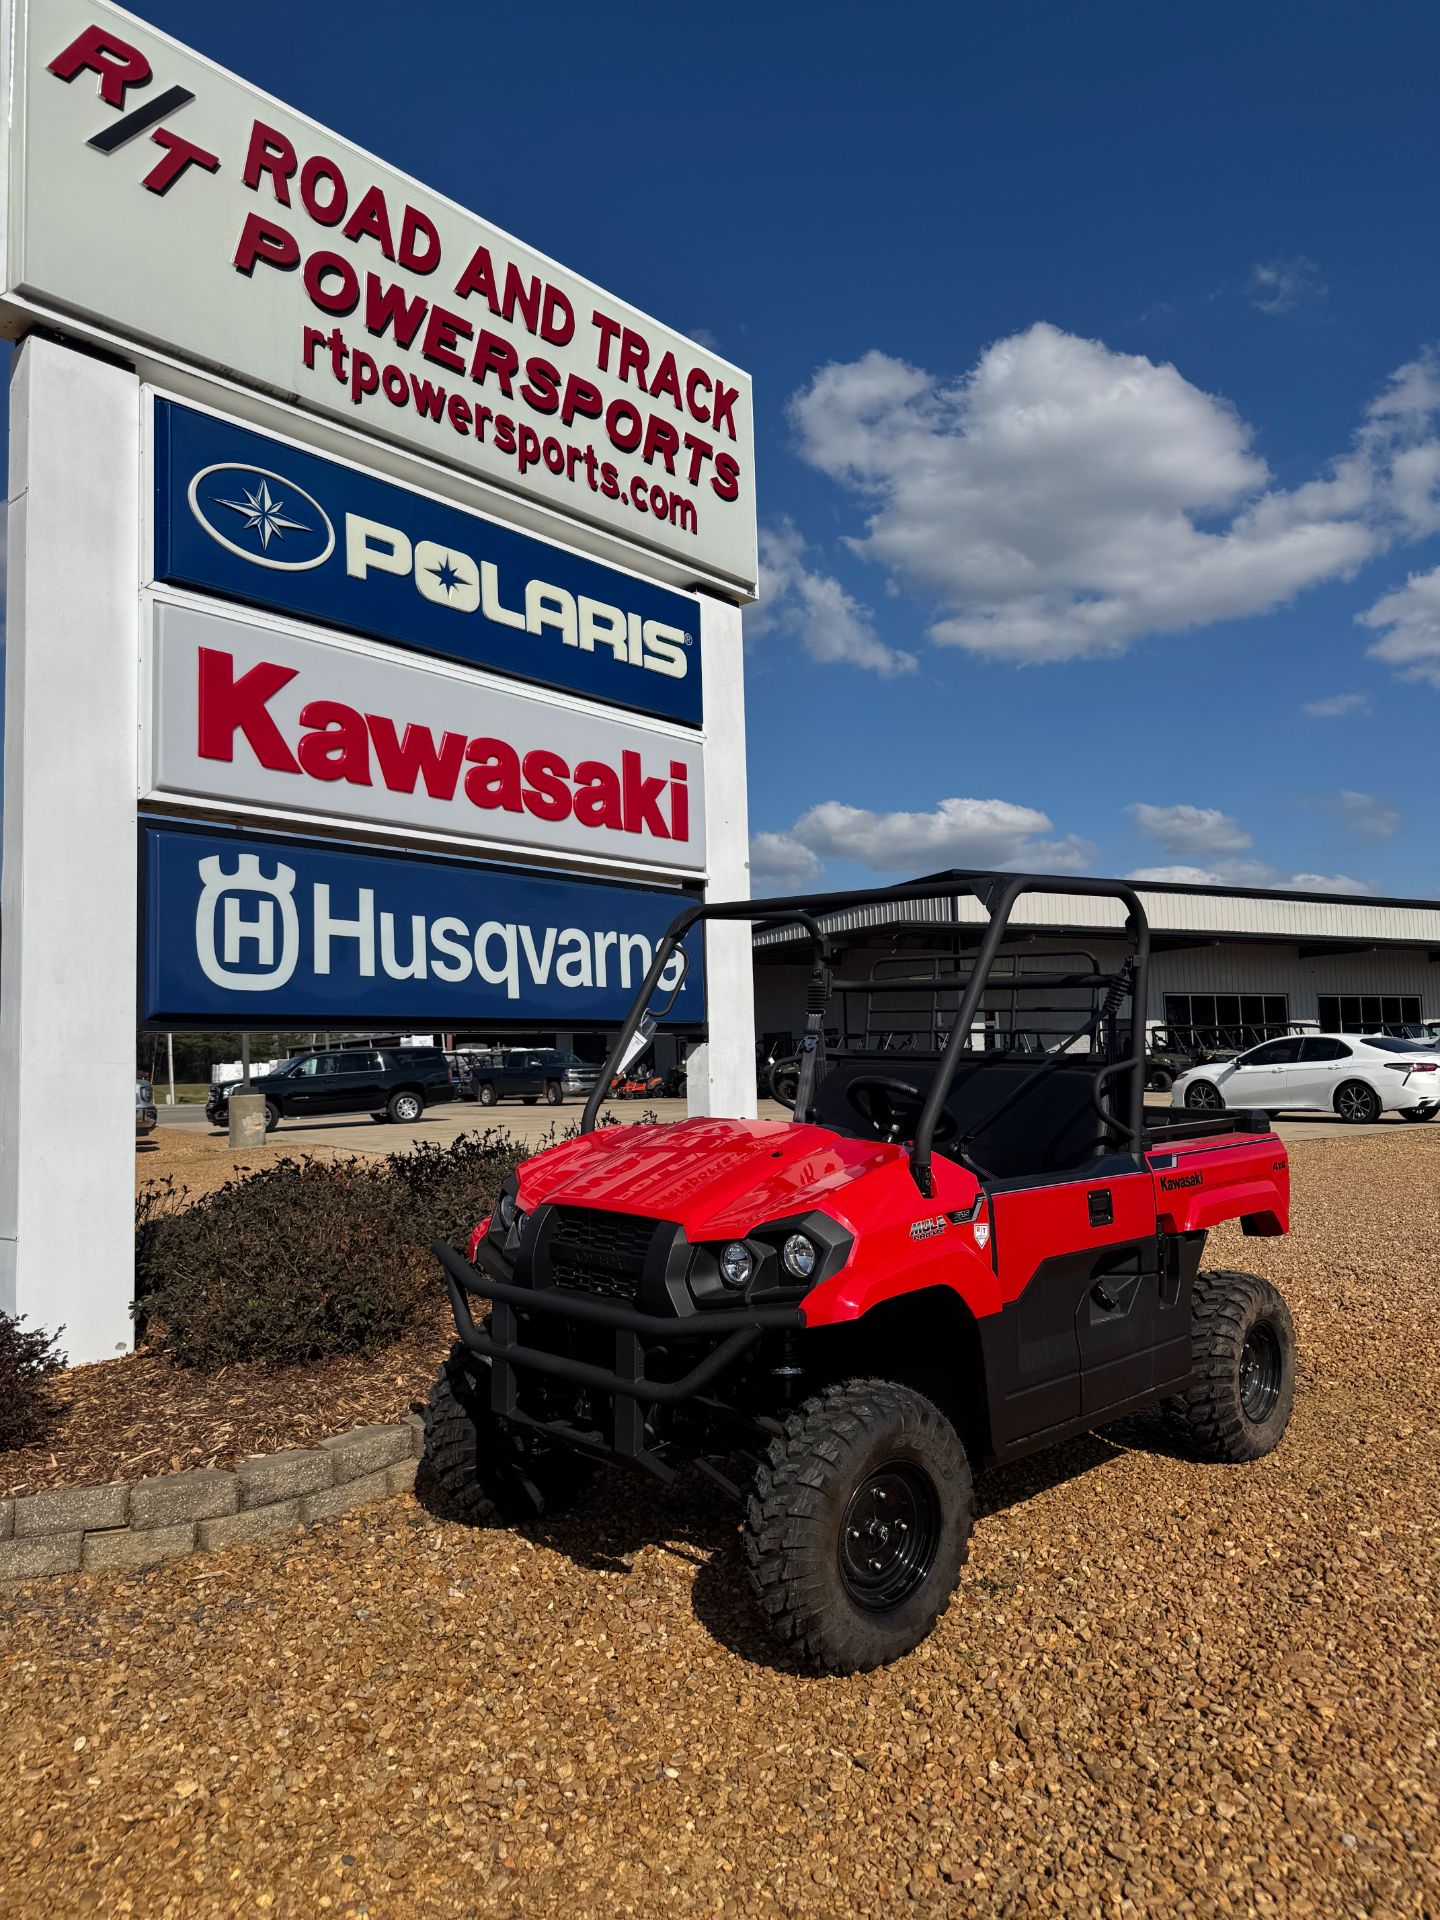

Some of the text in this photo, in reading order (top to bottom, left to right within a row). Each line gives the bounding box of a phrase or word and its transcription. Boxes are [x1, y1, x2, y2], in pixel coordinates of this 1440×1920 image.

[233, 213, 740, 499] POWERSPORTS
[243, 120, 739, 439] ROAD AND TRACK
[303, 326, 697, 533] rtpowersports.com
[197, 646, 689, 842] Kawasaki
[909, 1215, 947, 1237] MULE
[1160, 1171, 1203, 1191] Kawasaki
